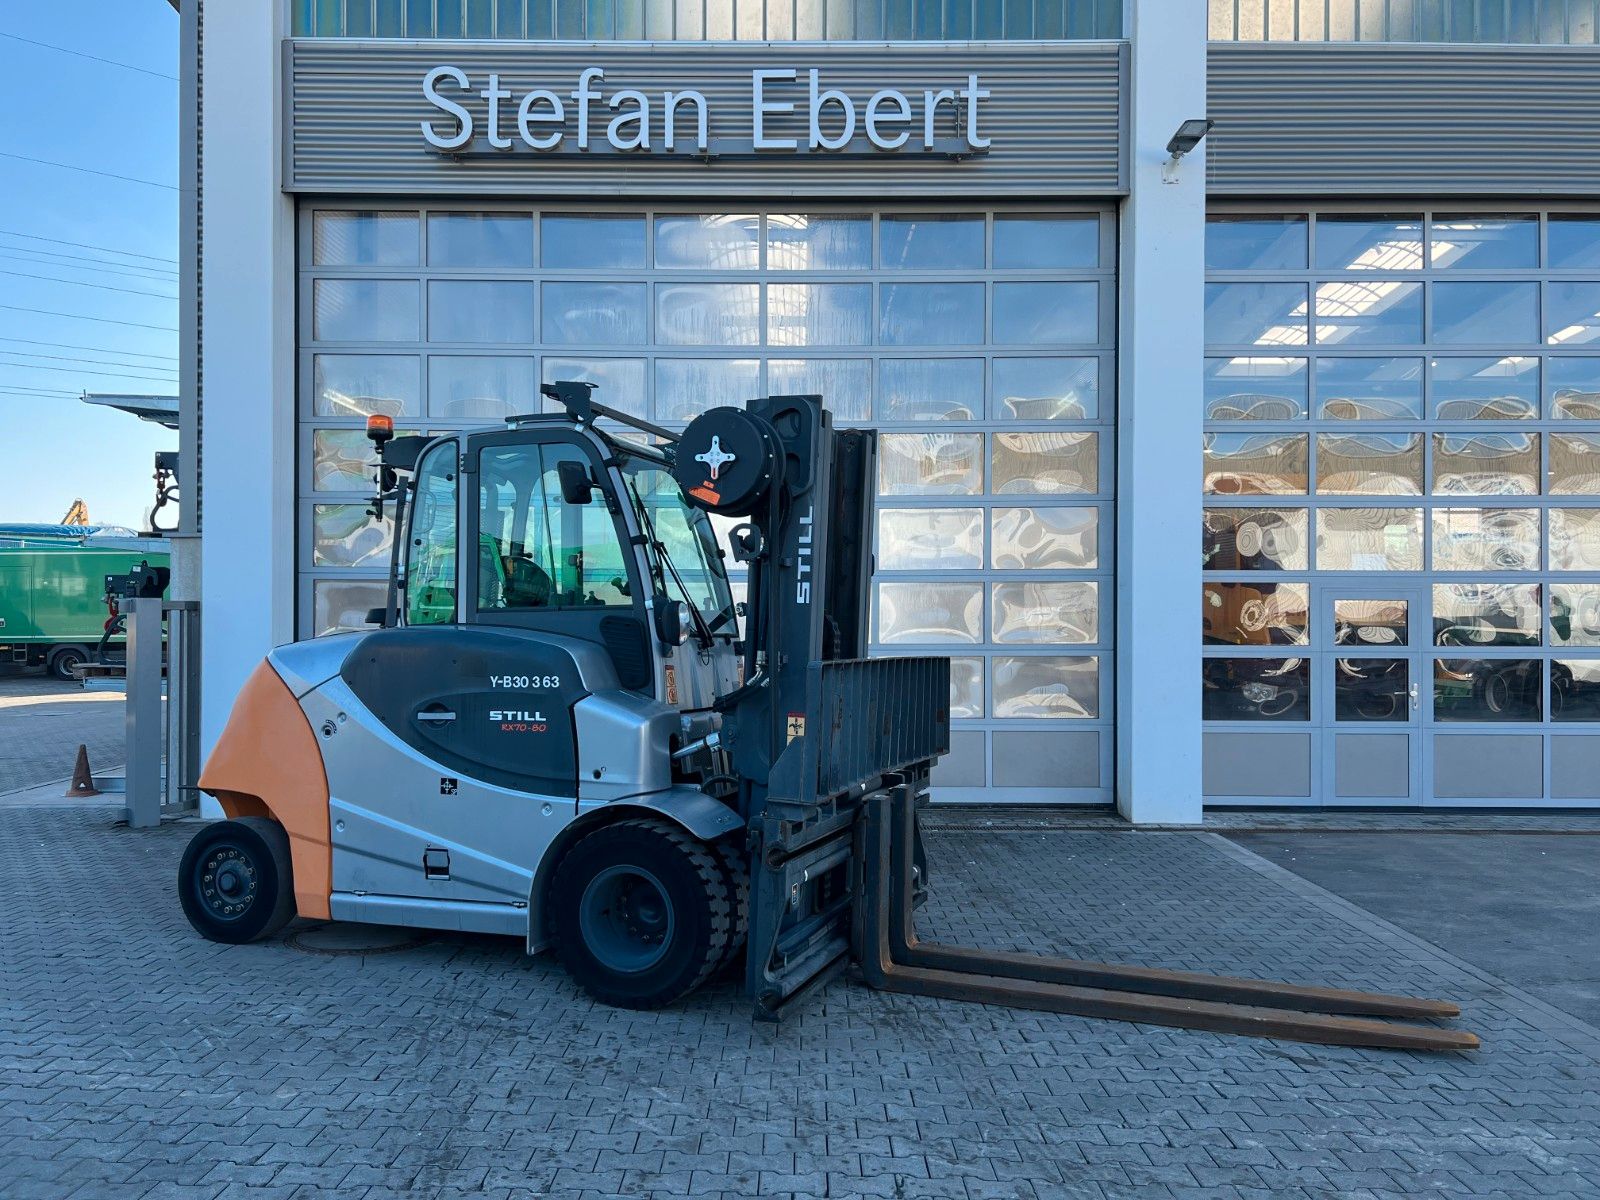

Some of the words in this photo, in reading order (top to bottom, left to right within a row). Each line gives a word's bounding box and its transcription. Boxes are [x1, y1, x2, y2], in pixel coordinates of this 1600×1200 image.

[421, 66, 708, 150] Stefan
[752, 68, 991, 150] Ebert
[796, 506, 813, 604] STILL
[489, 710, 547, 721] STILL
